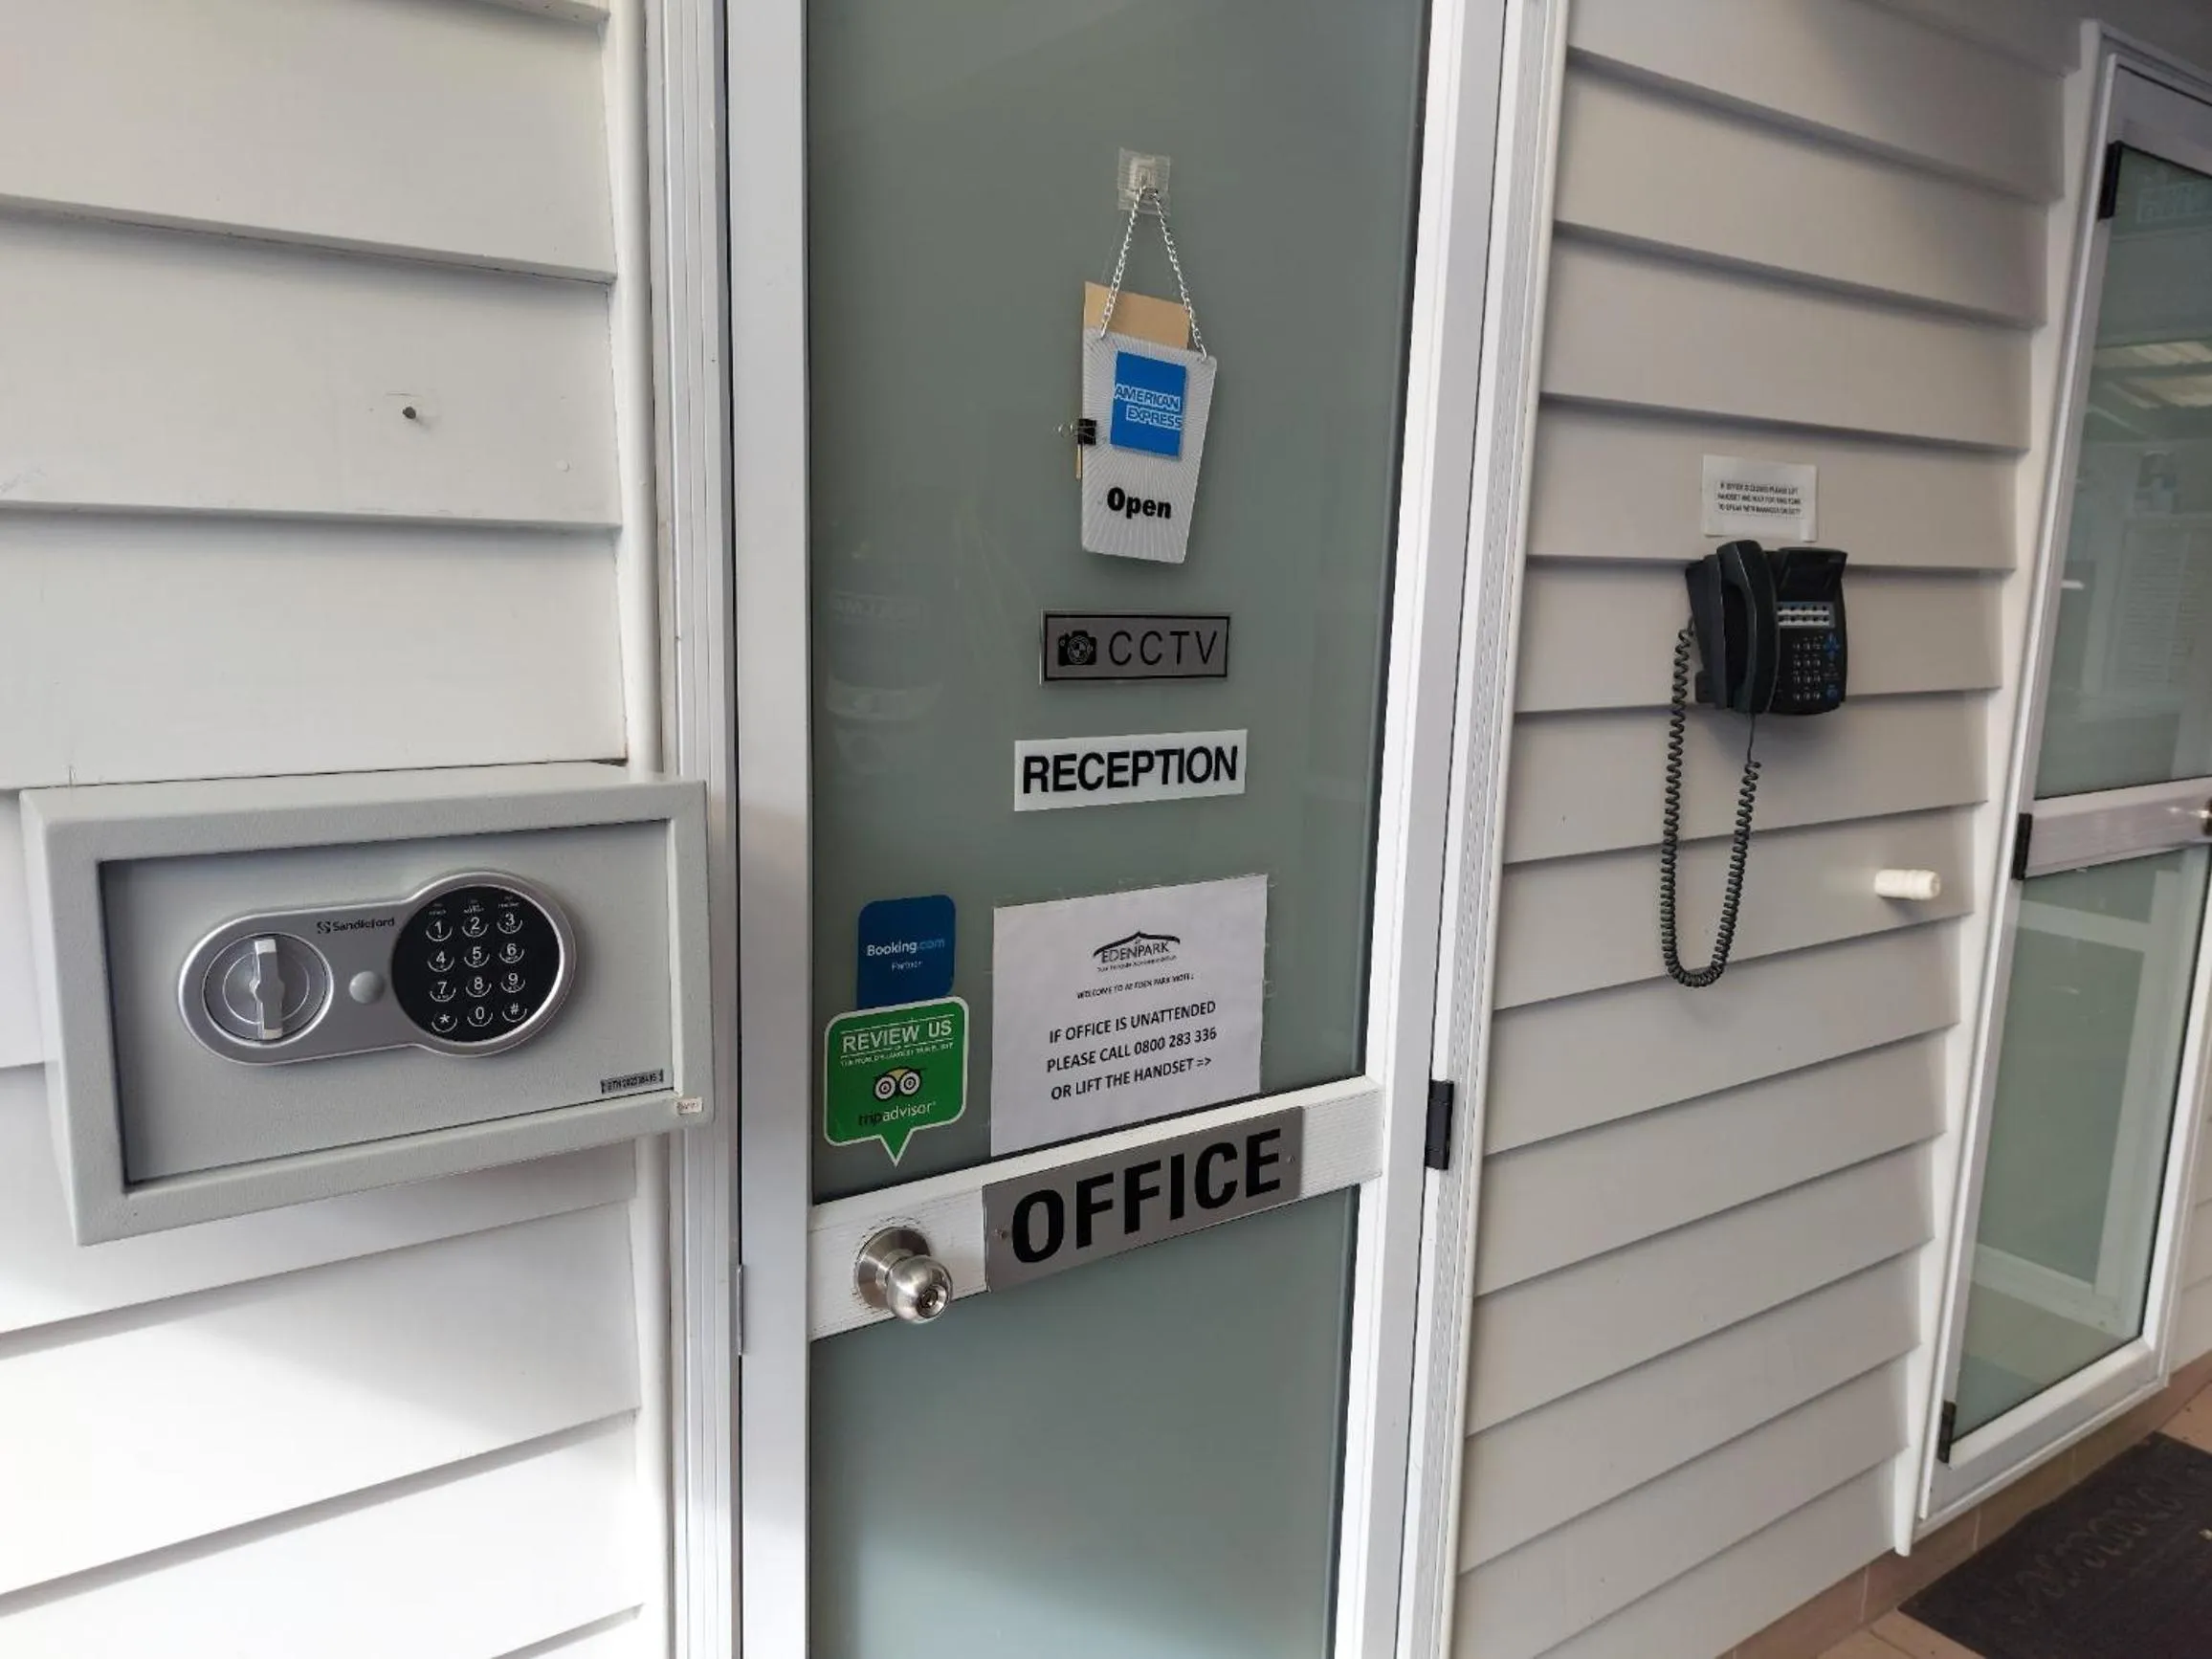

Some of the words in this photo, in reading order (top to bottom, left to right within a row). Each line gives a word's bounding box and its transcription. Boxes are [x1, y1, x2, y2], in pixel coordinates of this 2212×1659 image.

[1115, 385, 1180, 410] AMERICAN
[1126, 407, 1182, 429] EXPRESS
[1107, 487, 1172, 520] Open
[1109, 630, 1217, 666] CCTV
[1023, 745, 1238, 794] RECEPTION
[333, 918, 395, 932] Sandleford
[470, 917, 480, 930] 2
[505, 913, 516, 926] 3
[436, 950, 447, 963] 4
[472, 946, 482, 960] 5
[506, 942, 517, 956] 6
[867, 937, 946, 958] Booking.com
[438, 981, 448, 994] 7
[474, 976, 483, 990] 8
[508, 972, 519, 985] 9
[842, 1025, 920, 1053] REVIEW
[928, 1019, 953, 1038] US
[1050, 1029, 1062, 1044] IF
[1065, 1020, 1112, 1041] OFFICE
[1116, 1018, 1128, 1032] IS
[1131, 1000, 1216, 1029] UNATTENDED
[1047, 1051, 1096, 1073] PLEASE
[1099, 1044, 1132, 1064] CALL
[1134, 1036, 1166, 1055] 0800
[1169, 1031, 1192, 1049] 283
[1194, 1027, 1217, 1044] 336
[1051, 1083, 1072, 1100] OR
[1075, 1077, 1102, 1095] LIFT
[1106, 1072, 1130, 1091] THE
[1134, 1057, 1194, 1083] HANDSET
[858, 1102, 933, 1126] tripadvisor
[1011, 1128, 1282, 1264] OFFICE
